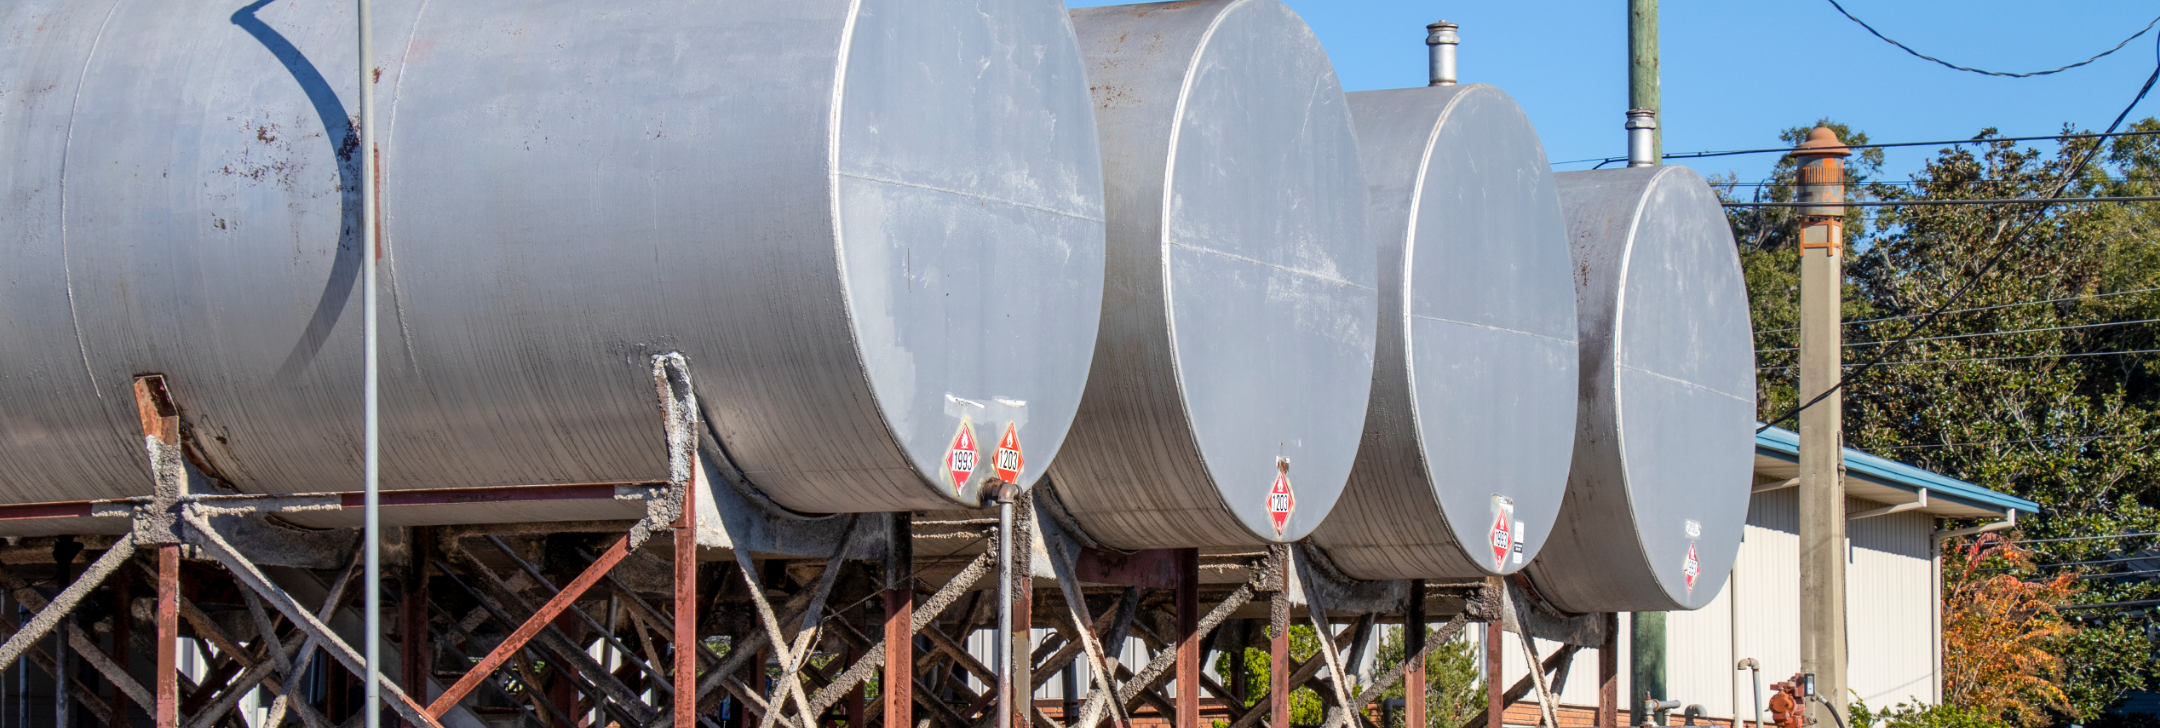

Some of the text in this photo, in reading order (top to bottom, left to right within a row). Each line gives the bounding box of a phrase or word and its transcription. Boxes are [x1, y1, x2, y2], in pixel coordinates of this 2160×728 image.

[954, 451, 973, 471] 1993
[1000, 450, 1018, 471] 1203
[1272, 494, 1288, 511] 1203
[1496, 530, 1507, 548] 1993
